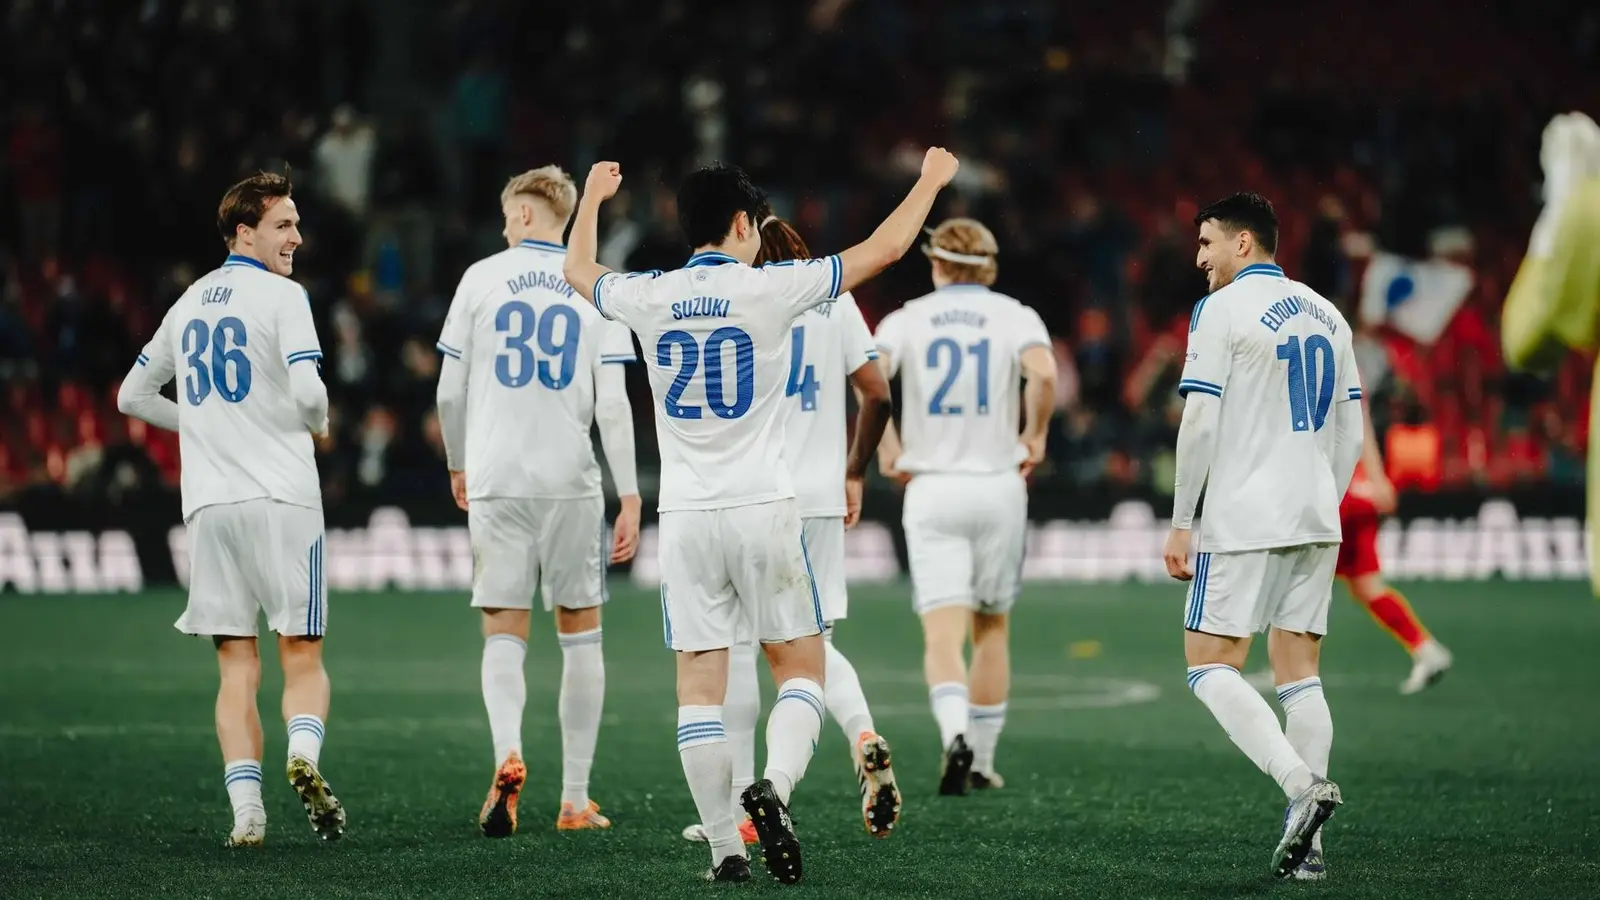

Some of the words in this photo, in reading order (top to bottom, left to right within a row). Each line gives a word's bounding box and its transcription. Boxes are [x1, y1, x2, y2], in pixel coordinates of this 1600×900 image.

[506, 271, 575, 299] DADASON
[671, 296, 730, 320] SUZUKI
[1260, 295, 1337, 335] ELYOUNOUSSI
[182, 316, 251, 407] 36
[495, 301, 581, 391] 39
[656, 326, 753, 419] 20
[926, 337, 989, 415] 21
[1276, 334, 1335, 432] 10
